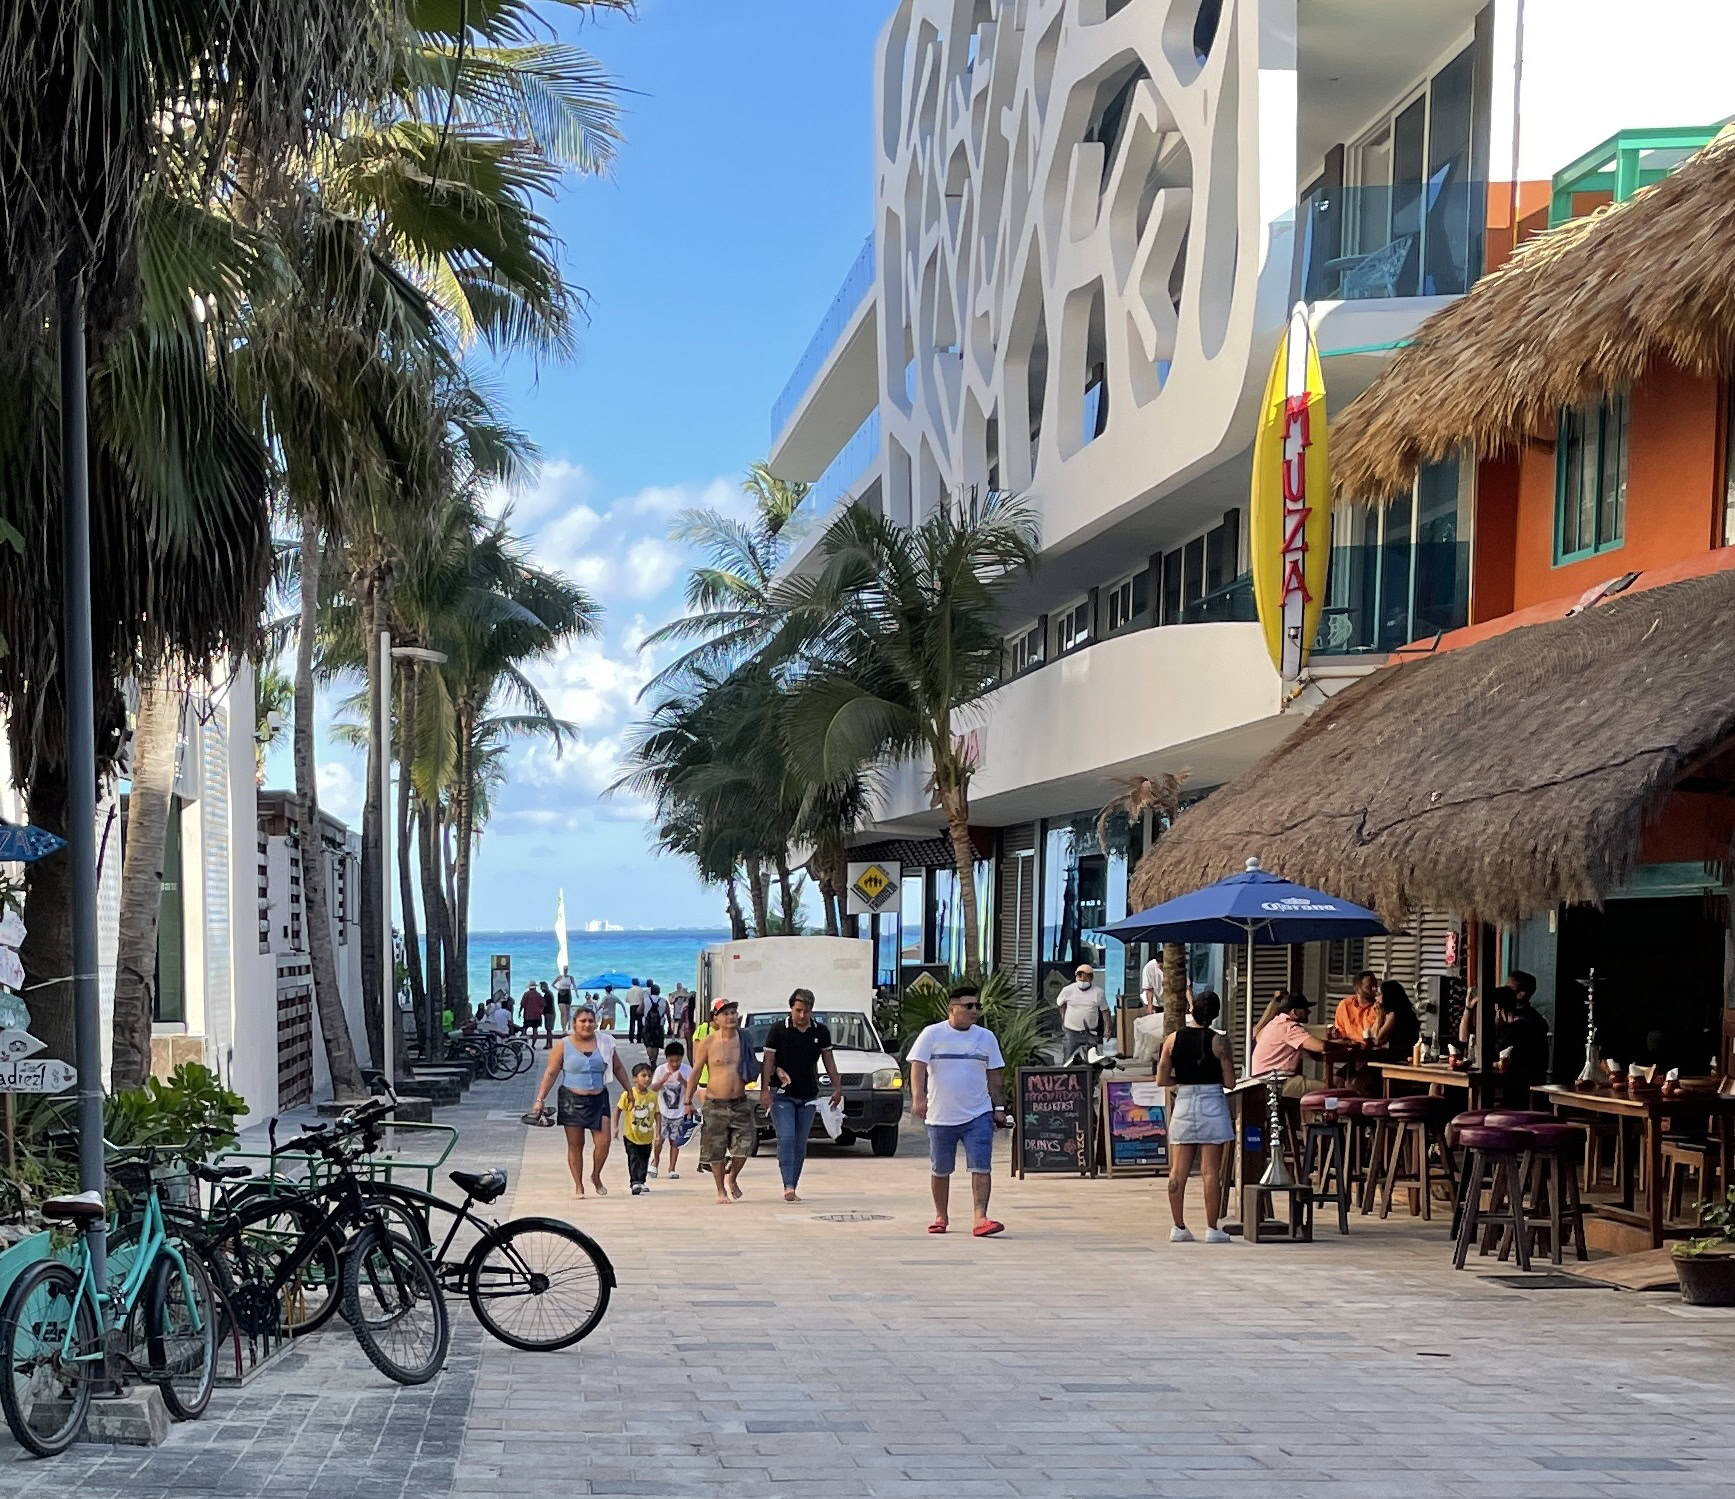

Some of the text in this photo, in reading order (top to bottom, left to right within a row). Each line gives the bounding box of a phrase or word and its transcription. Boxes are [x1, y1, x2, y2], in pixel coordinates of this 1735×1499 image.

[1279, 391, 1314, 608] MUZA
[1261, 902, 1337, 912] Corona
[1027, 1074, 1080, 1091] MUZA
[1032, 1101, 1074, 1112] BREAKFAST
[1024, 1138, 1061, 1152] DRINKS
[1075, 1121, 1087, 1167] LUNCH
